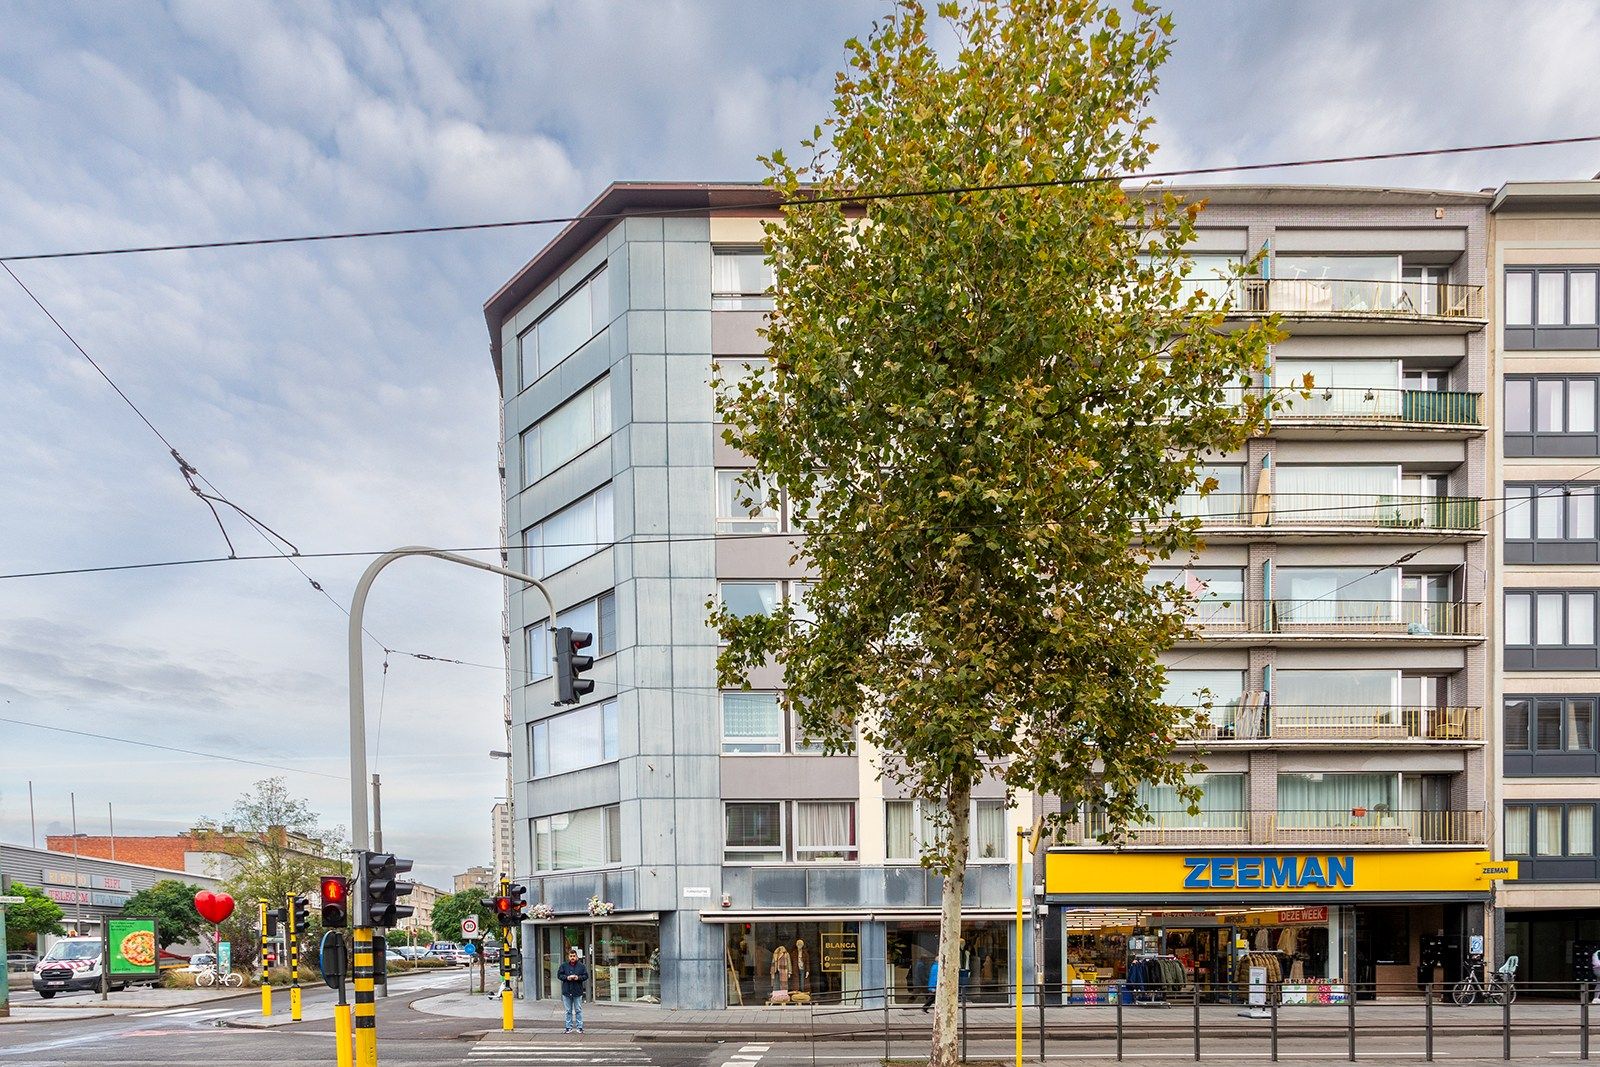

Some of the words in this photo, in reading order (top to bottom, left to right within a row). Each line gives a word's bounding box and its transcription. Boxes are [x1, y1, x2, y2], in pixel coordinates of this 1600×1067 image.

[1184, 856, 1355, 888] ZEEMAN
[48, 889, 88, 903] TELECM
[1281, 909, 1300, 921] DEZE
[1301, 908, 1323, 920] WEEK
